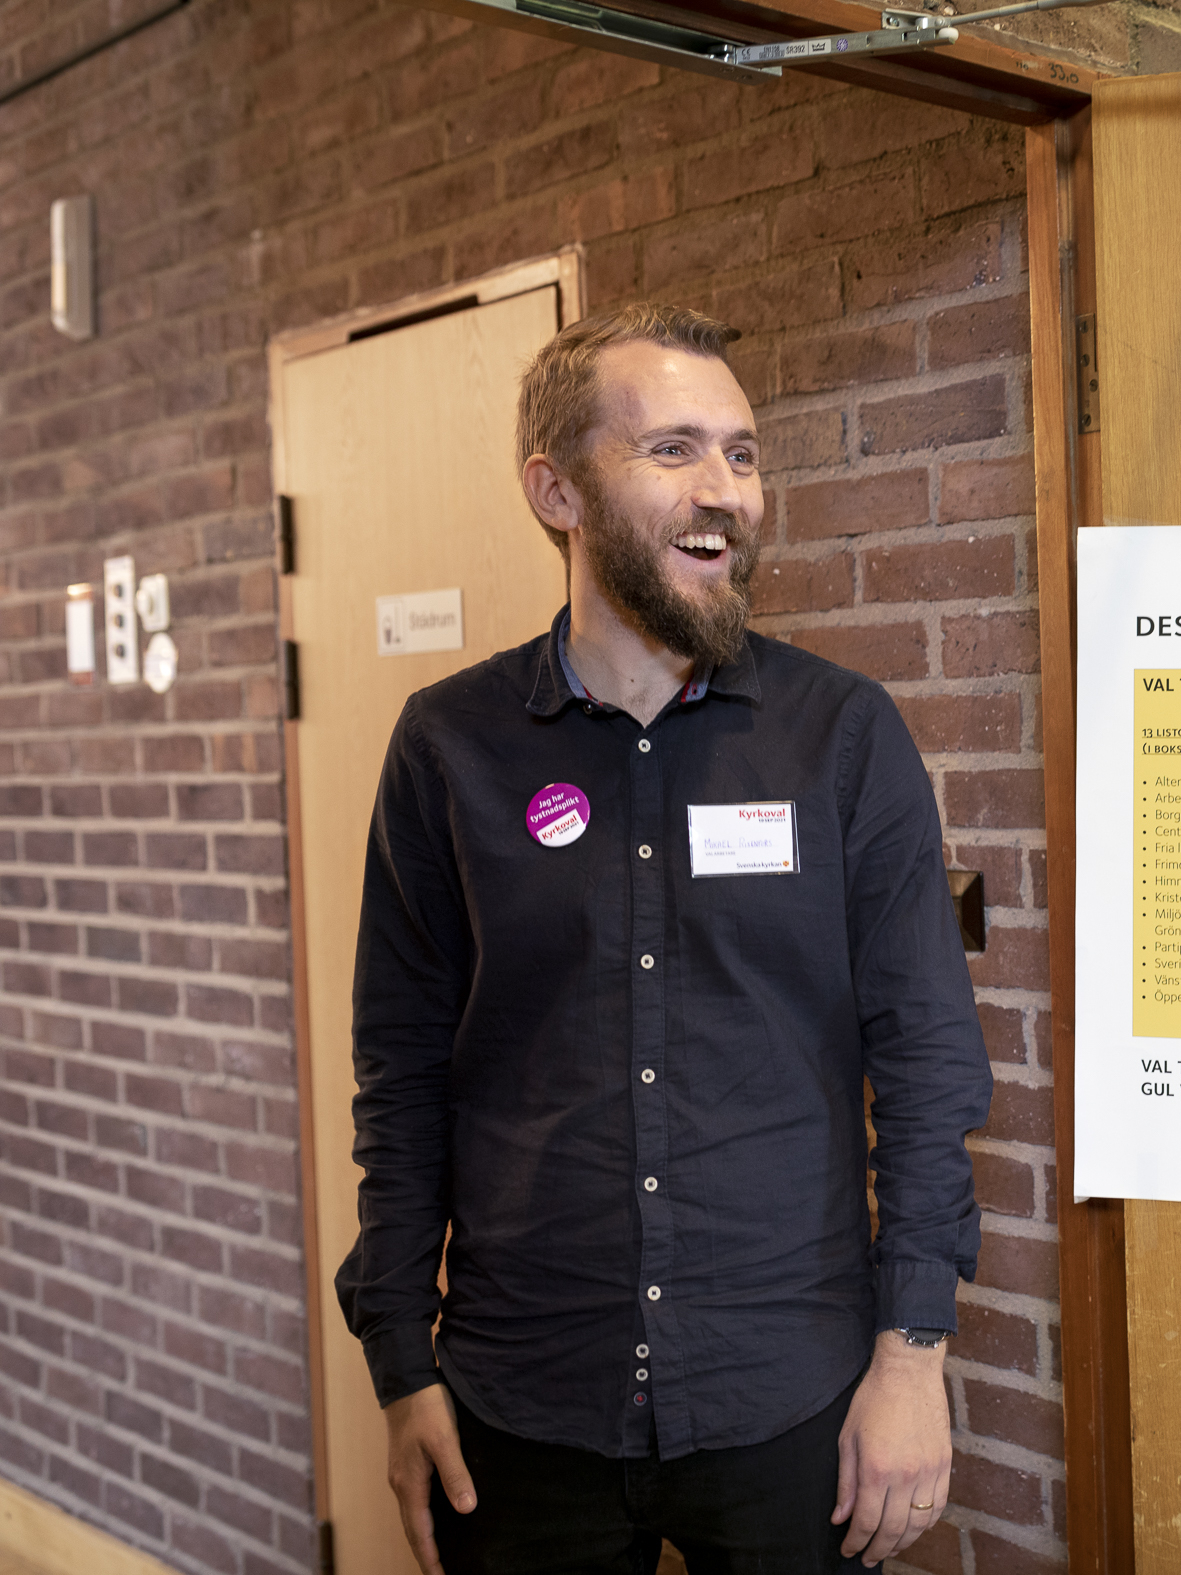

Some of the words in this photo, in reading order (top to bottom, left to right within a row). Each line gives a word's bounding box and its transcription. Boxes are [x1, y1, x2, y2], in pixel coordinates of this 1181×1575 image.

[786, 44, 806, 54] SR392
[1142, 678, 1175, 692] VAL
[1141, 727, 1154, 739] 13
[1142, 742, 1151, 755] (I
[538, 798, 552, 809] Jag
[552, 792, 565, 803] har
[530, 796, 580, 824] tystnadsplikt
[738, 808, 786, 820] Kyrkoval
[541, 814, 578, 840] Kyrkoval
[1155, 842, 1175, 854] Fria
[1141, 1059, 1172, 1074] VAL
[1141, 1082, 1175, 1097] GUL
